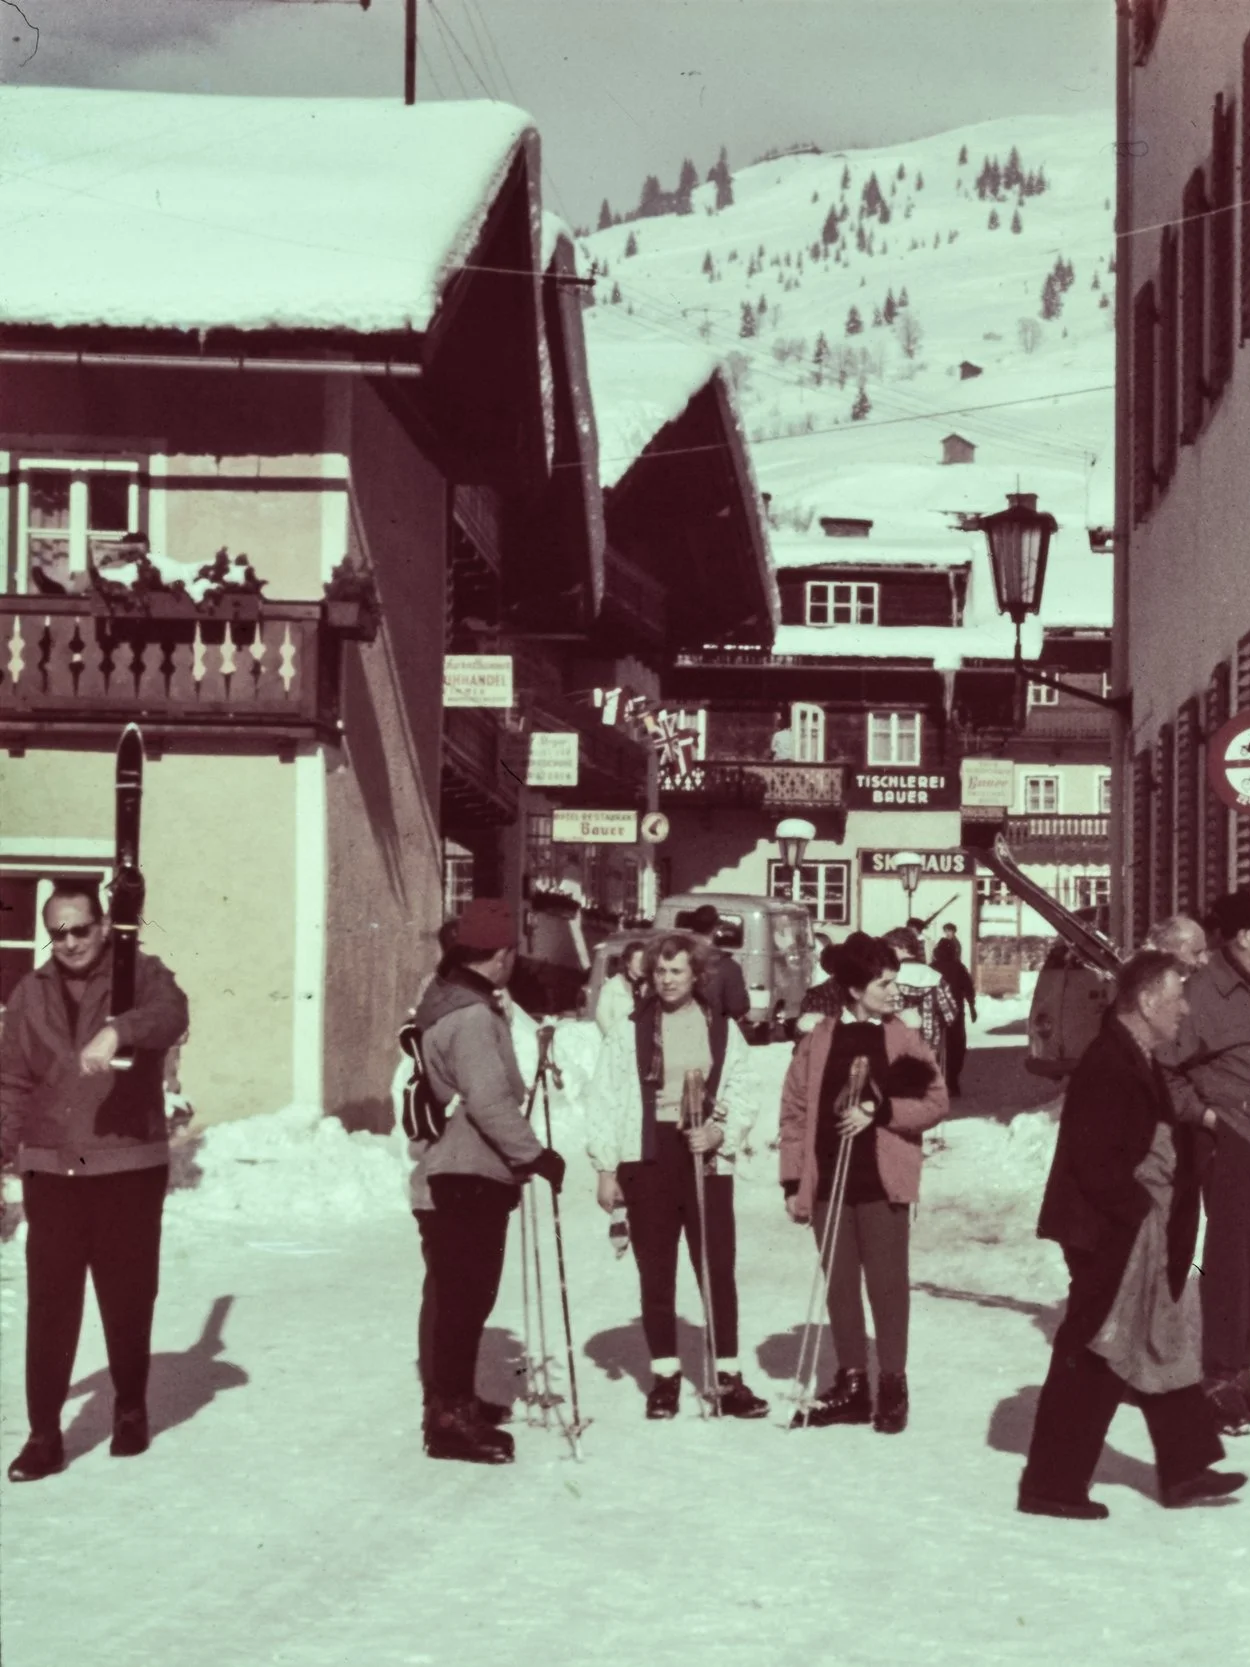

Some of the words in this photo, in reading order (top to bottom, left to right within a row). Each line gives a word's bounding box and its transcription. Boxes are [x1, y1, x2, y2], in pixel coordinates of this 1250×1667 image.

[855, 774, 945, 789] TISCHLEREI
[872, 790, 928, 804] BAUER
[580, 822, 625, 836] Bauer
